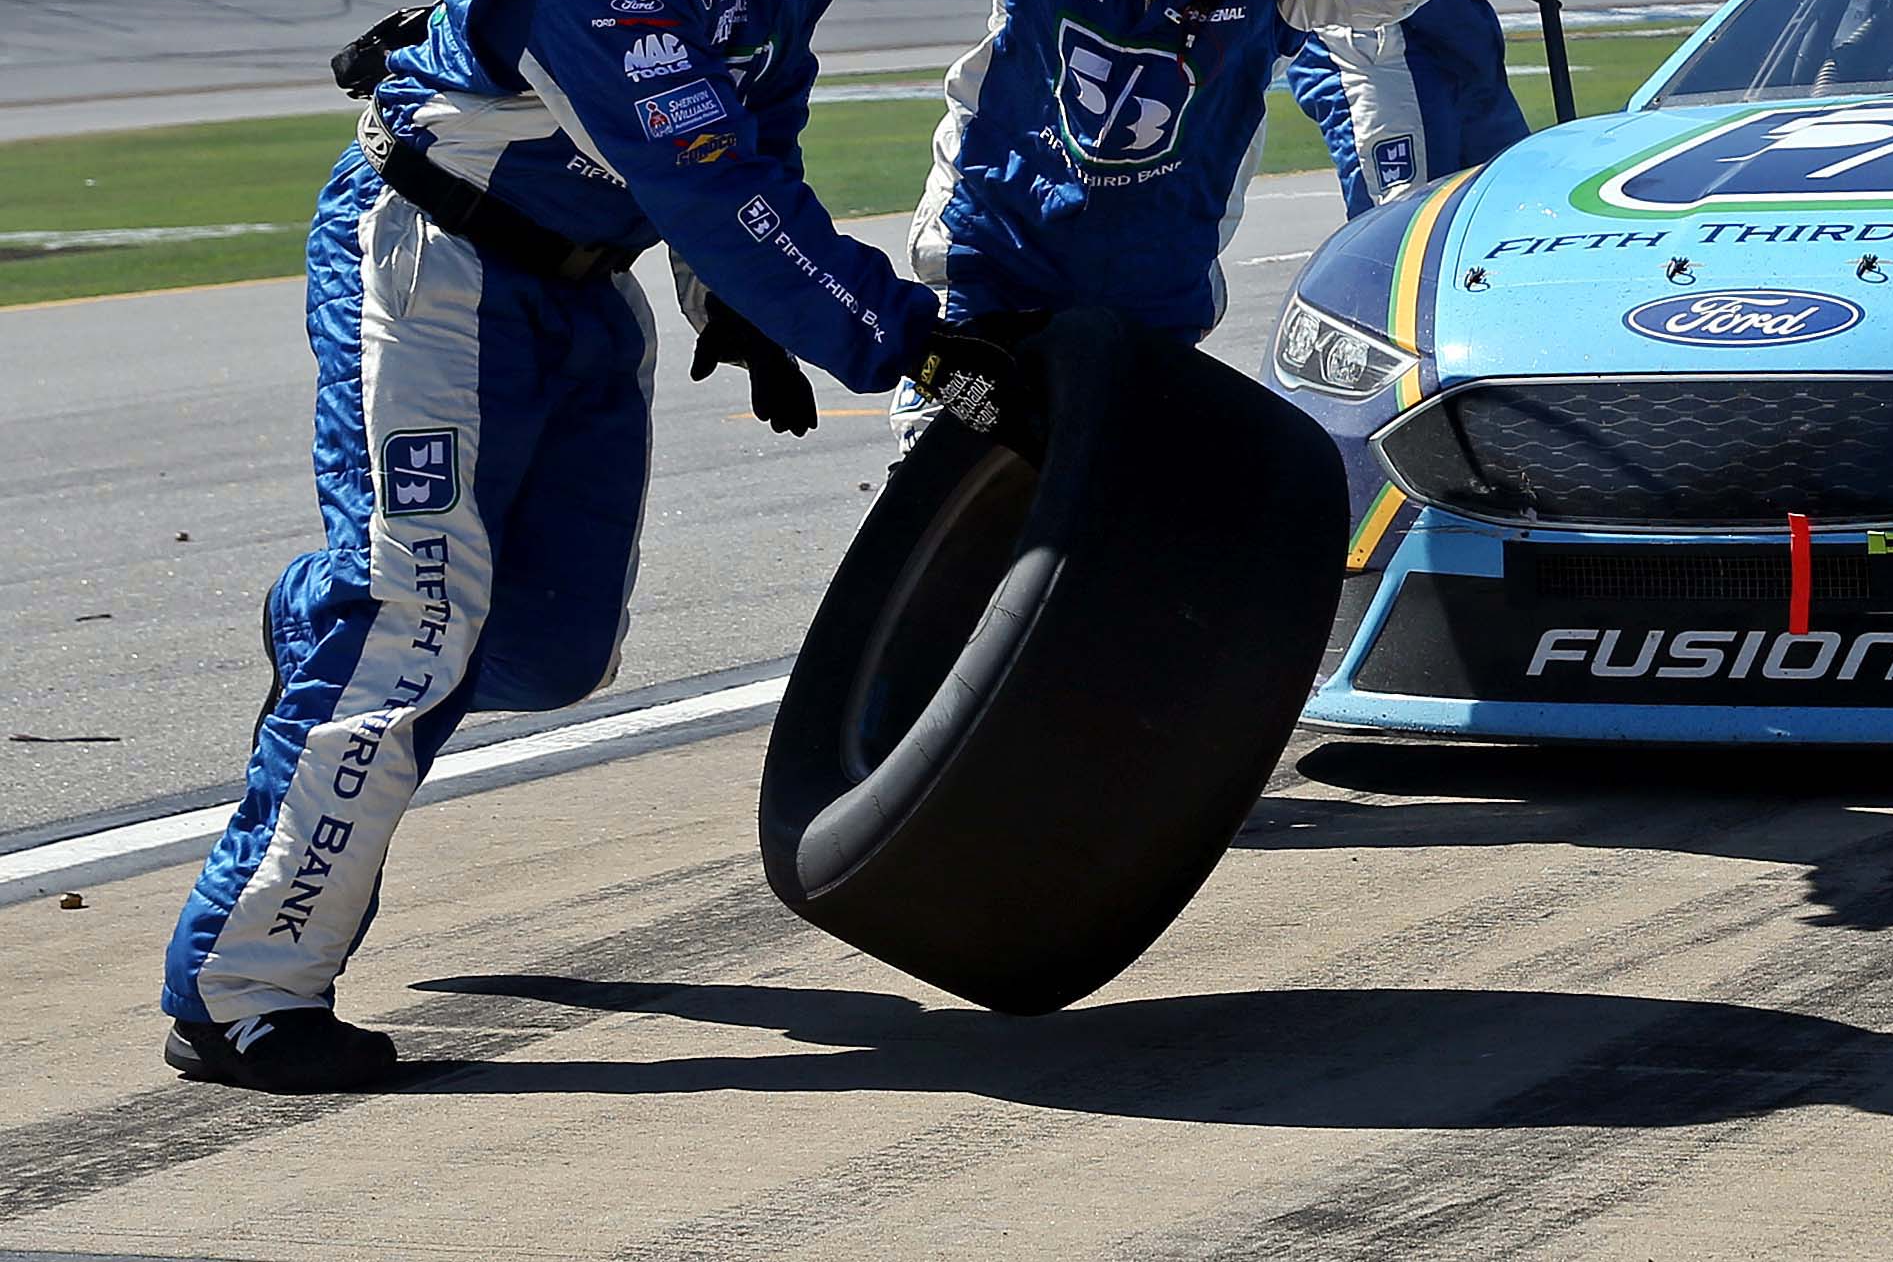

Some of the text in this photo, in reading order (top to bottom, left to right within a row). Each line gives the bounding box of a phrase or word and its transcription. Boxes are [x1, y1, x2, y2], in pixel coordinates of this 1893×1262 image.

[624, 33, 688, 72] MAC
[627, 59, 692, 82] TOOLS
[1484, 226, 1686, 260] FIFTH
[774, 231, 819, 277] FIFTH
[819, 272, 859, 315] THIRD
[1650, 294, 1834, 340] Ford
[269, 534, 450, 944] FIFTH THIRD BANK
